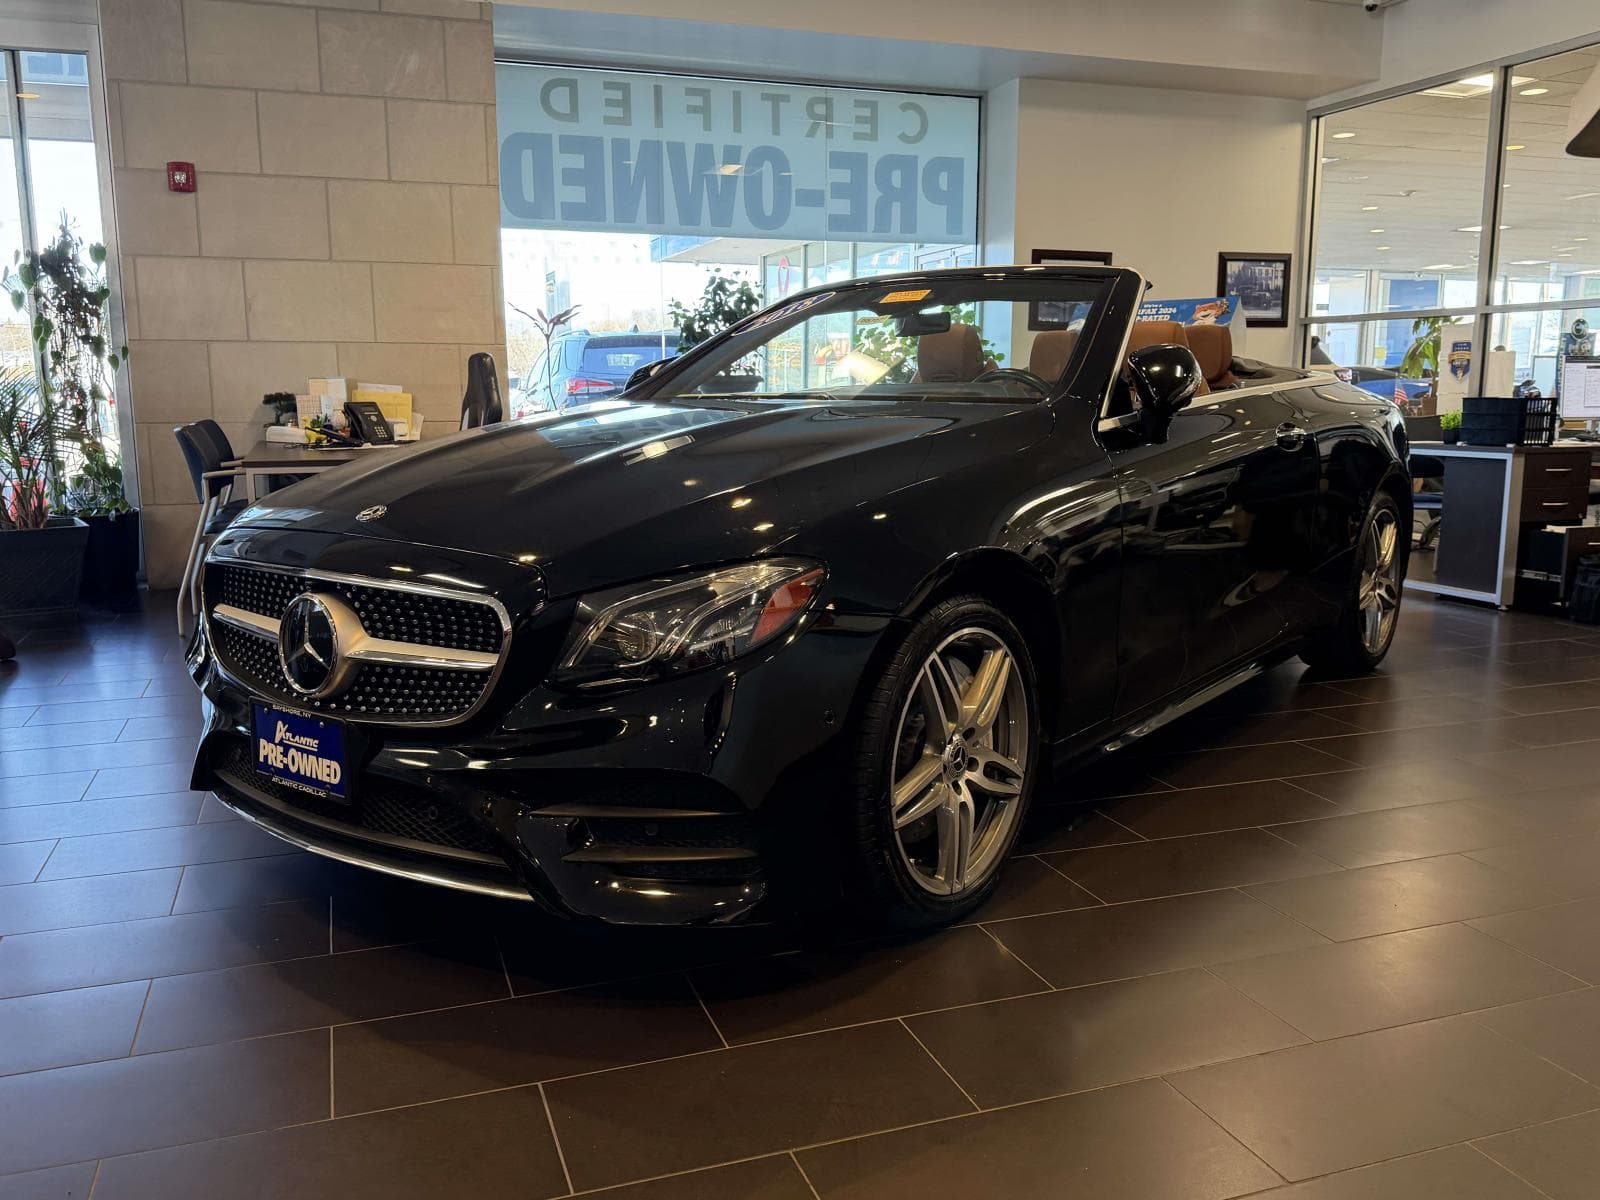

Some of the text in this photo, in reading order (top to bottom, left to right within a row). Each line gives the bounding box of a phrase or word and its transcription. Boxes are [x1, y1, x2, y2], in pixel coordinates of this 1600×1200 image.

[259, 738, 342, 784] PRE-OWNED
[271, 777, 327, 798] ATLANTIC CADILLAC
